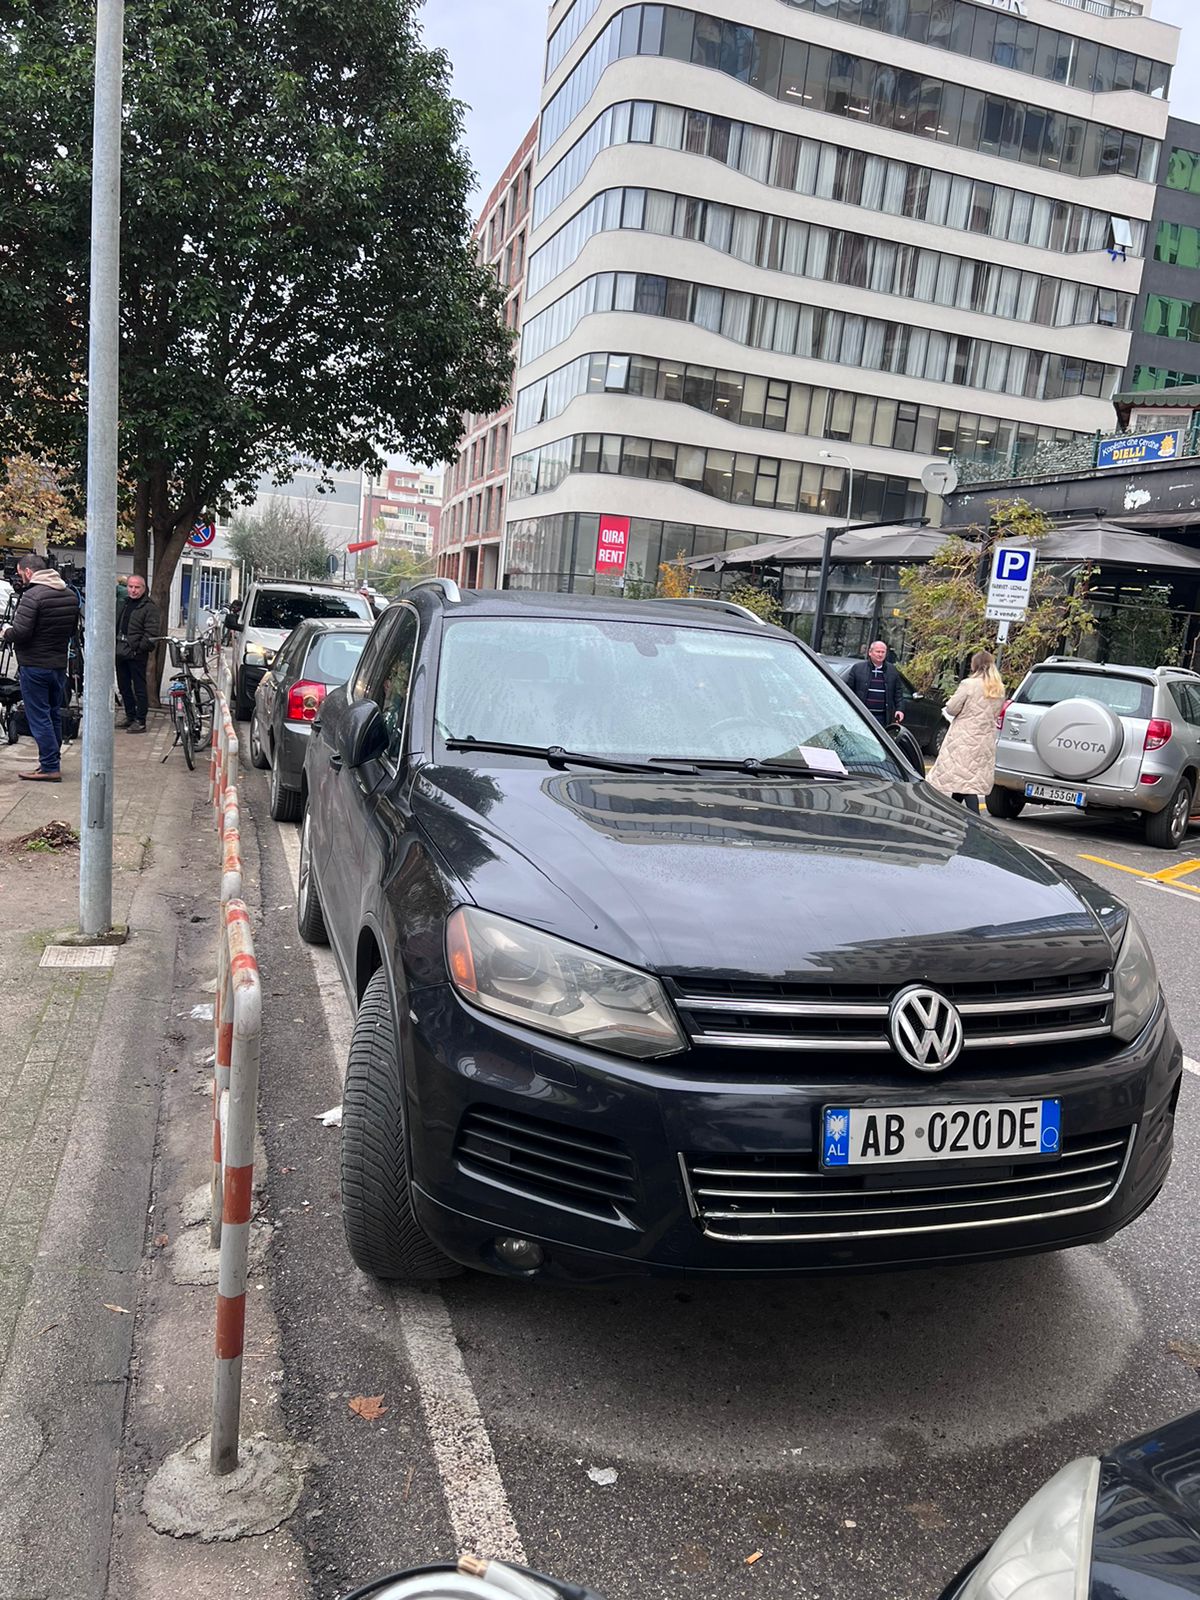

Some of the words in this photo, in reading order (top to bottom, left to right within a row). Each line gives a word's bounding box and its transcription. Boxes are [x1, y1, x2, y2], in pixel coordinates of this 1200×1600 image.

[1112, 446, 1146, 460] DIELLI
[601, 529, 625, 544] QIRA
[598, 549, 625, 564] RENT
[1001, 551, 1026, 578] P
[1056, 738, 1107, 754] TOYOTA
[1034, 786, 1045, 797] AA
[860, 1114, 905, 1157] AB
[827, 1143, 846, 1157] AL
